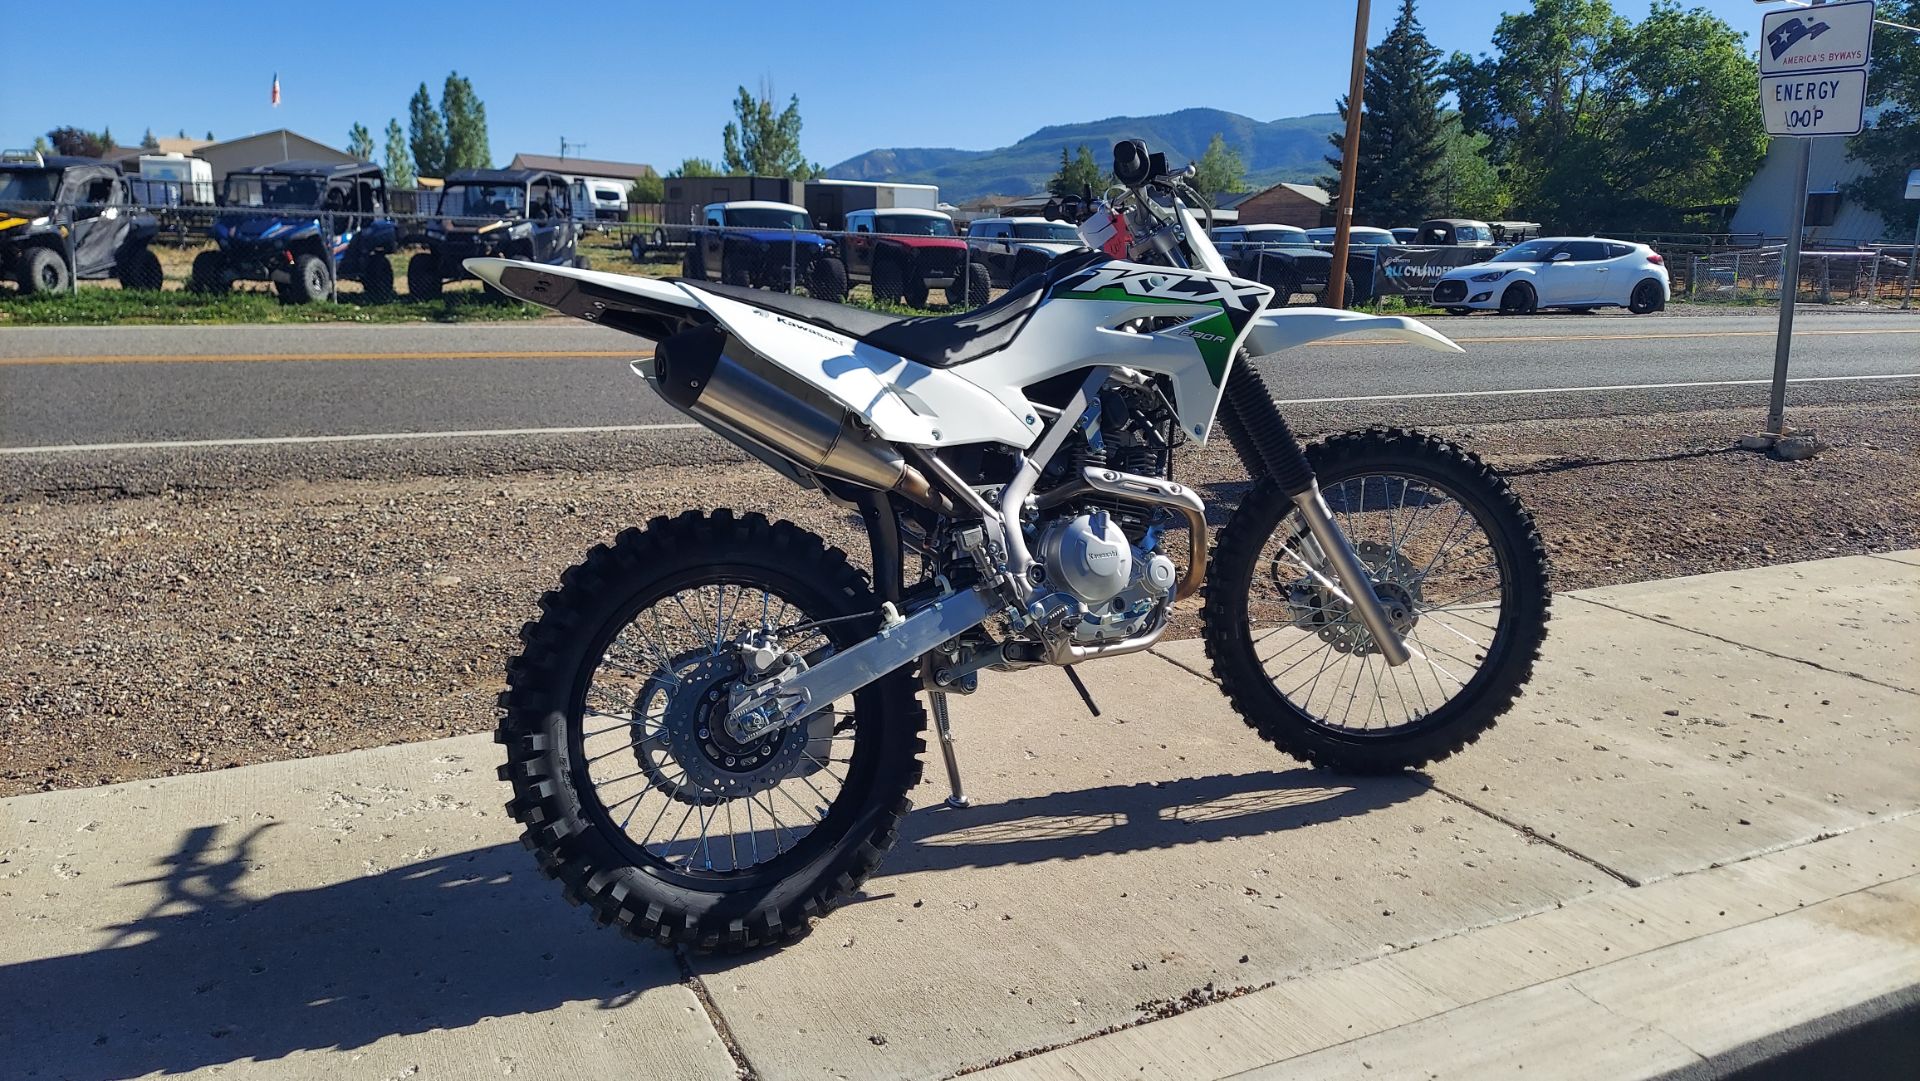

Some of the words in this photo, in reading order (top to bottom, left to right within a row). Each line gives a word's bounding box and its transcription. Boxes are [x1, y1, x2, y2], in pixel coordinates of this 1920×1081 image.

[1783, 53, 1825, 65] AMERICA'S
[1829, 50, 1862, 61] BYWAYS
[1775, 80, 1840, 101] ENERGY
[1784, 109, 1824, 128] LOOP
[1072, 268, 1272, 312] KLX
[777, 316, 844, 346] Kawasaki
[1178, 328, 1227, 344] 230R
